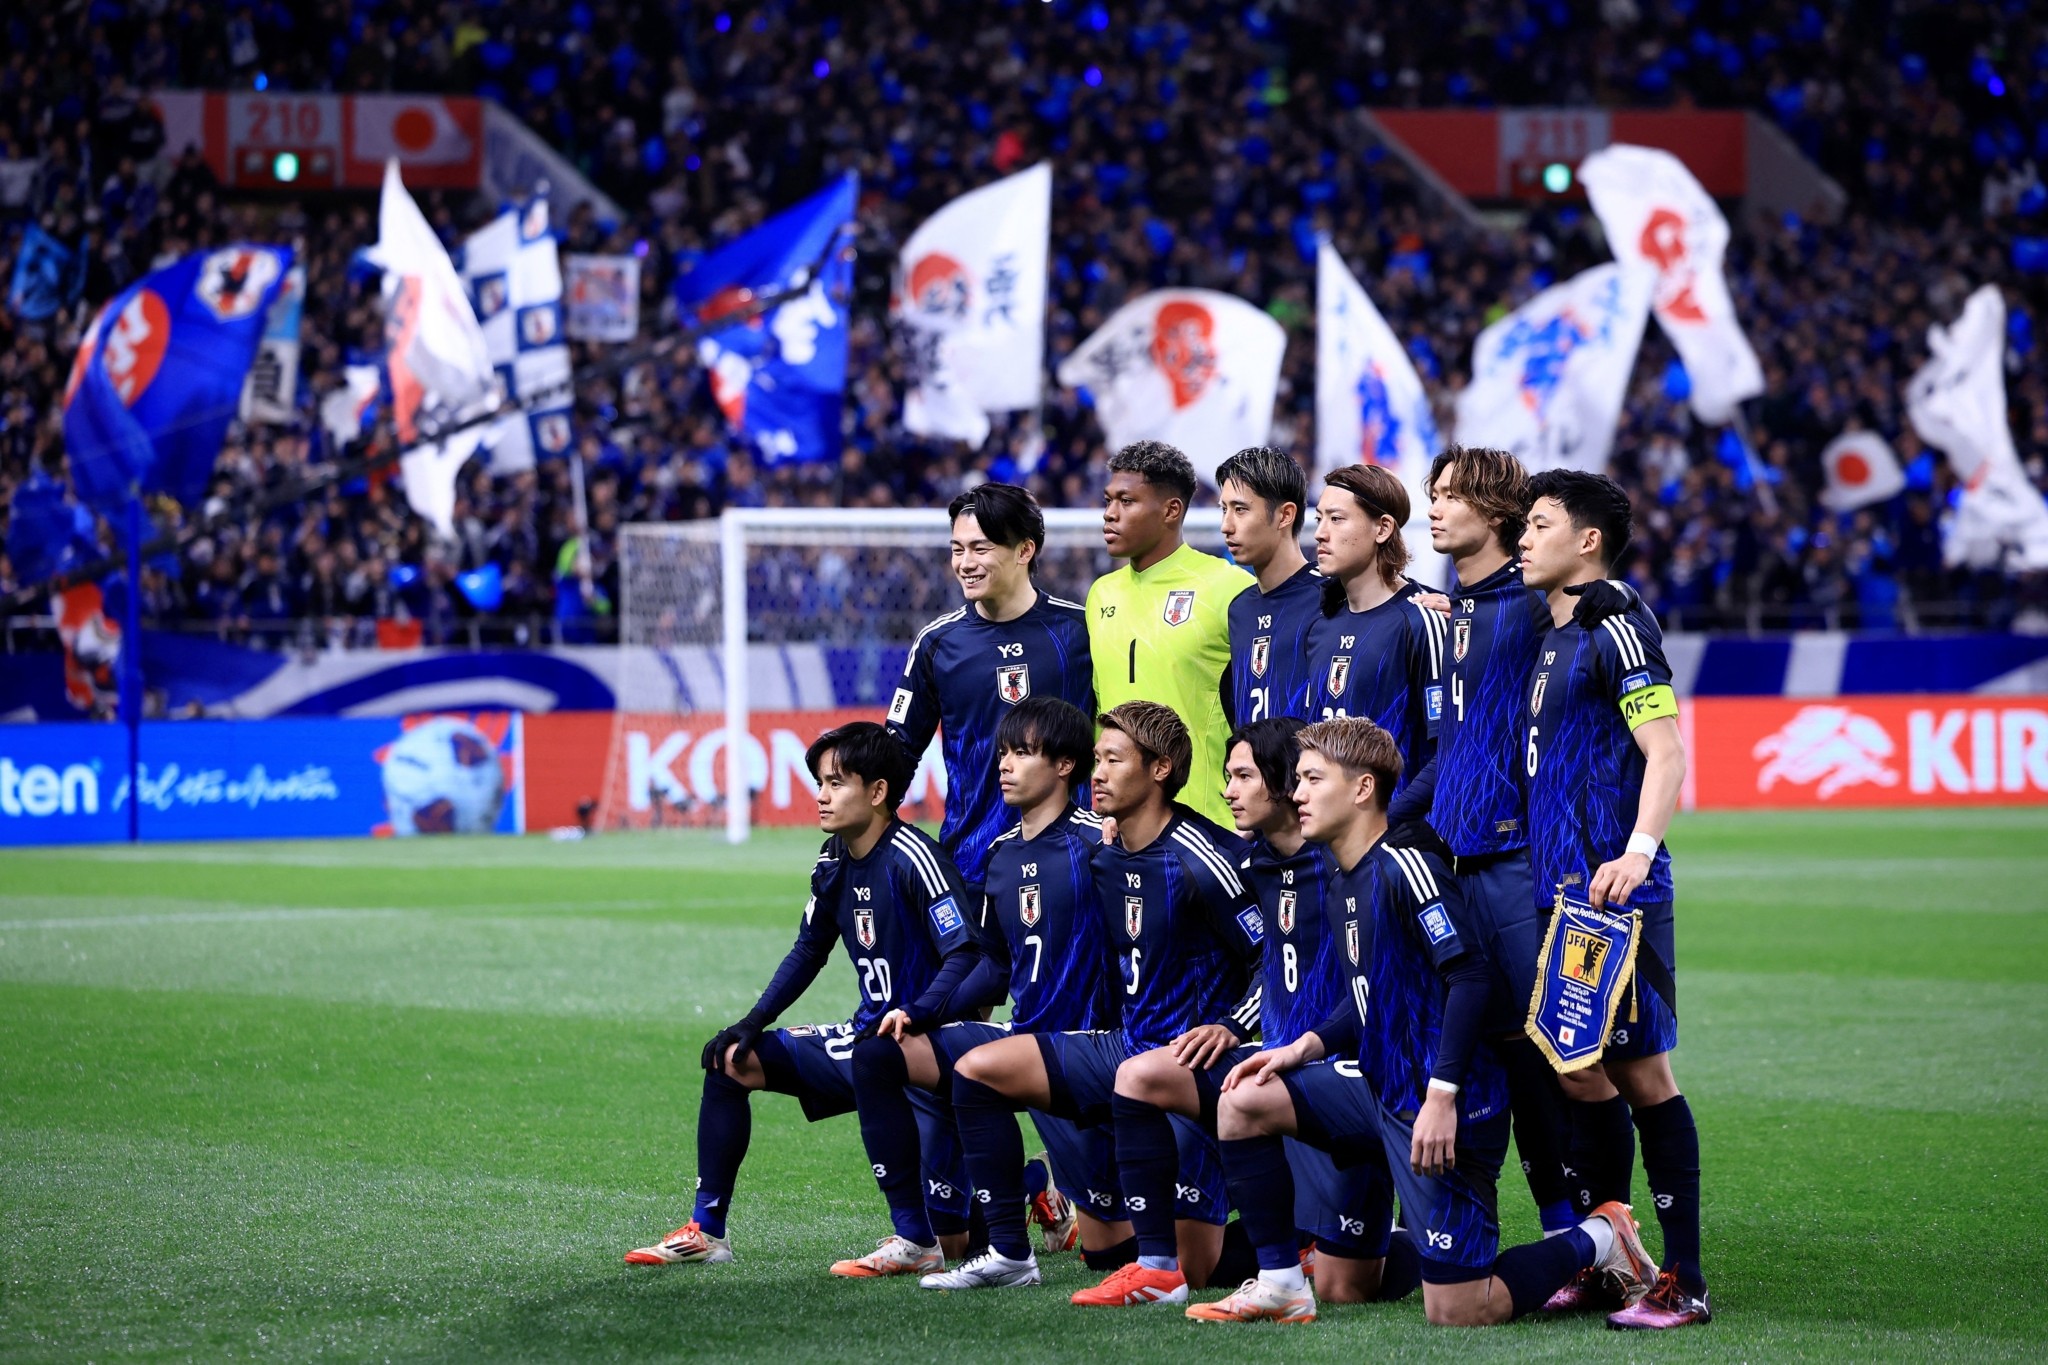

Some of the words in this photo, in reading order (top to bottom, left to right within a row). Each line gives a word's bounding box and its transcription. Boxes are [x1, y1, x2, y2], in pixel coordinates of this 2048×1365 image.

[247, 101, 321, 142] 210
[1100, 606, 1116, 619] Y-3
[1257, 615, 1272, 630] Y-3
[997, 643, 1024, 659] Y-3
[1339, 636, 1356, 650] Y-3
[1129, 638, 1137, 684] 1
[1250, 686, 1269, 723] 21
[1452, 671, 1464, 722] 4
[1626, 691, 1660, 721] AFC
[1526, 725, 1539, 778] 6
[1908, 711, 2048, 793] KIR
[1021, 863, 1038, 878] Y-3
[1125, 873, 1141, 888] Y-3
[1280, 868, 1294, 885] Y-3
[853, 887, 871, 901] Y-3
[1579, 908, 1603, 922] Football
[1567, 933, 1586, 949] JFA
[1025, 935, 1042, 983] 7
[1282, 942, 1298, 993] 8
[858, 957, 892, 1002] 20
[1126, 947, 1142, 995] 5
[928, 1179, 952, 1199] Y-3
[1087, 1188, 1112, 1207] Y-3
[1175, 1183, 1200, 1203] Y-3
[1339, 1214, 1364, 1236] Y-3
[1426, 1229, 1452, 1250] Y-3
